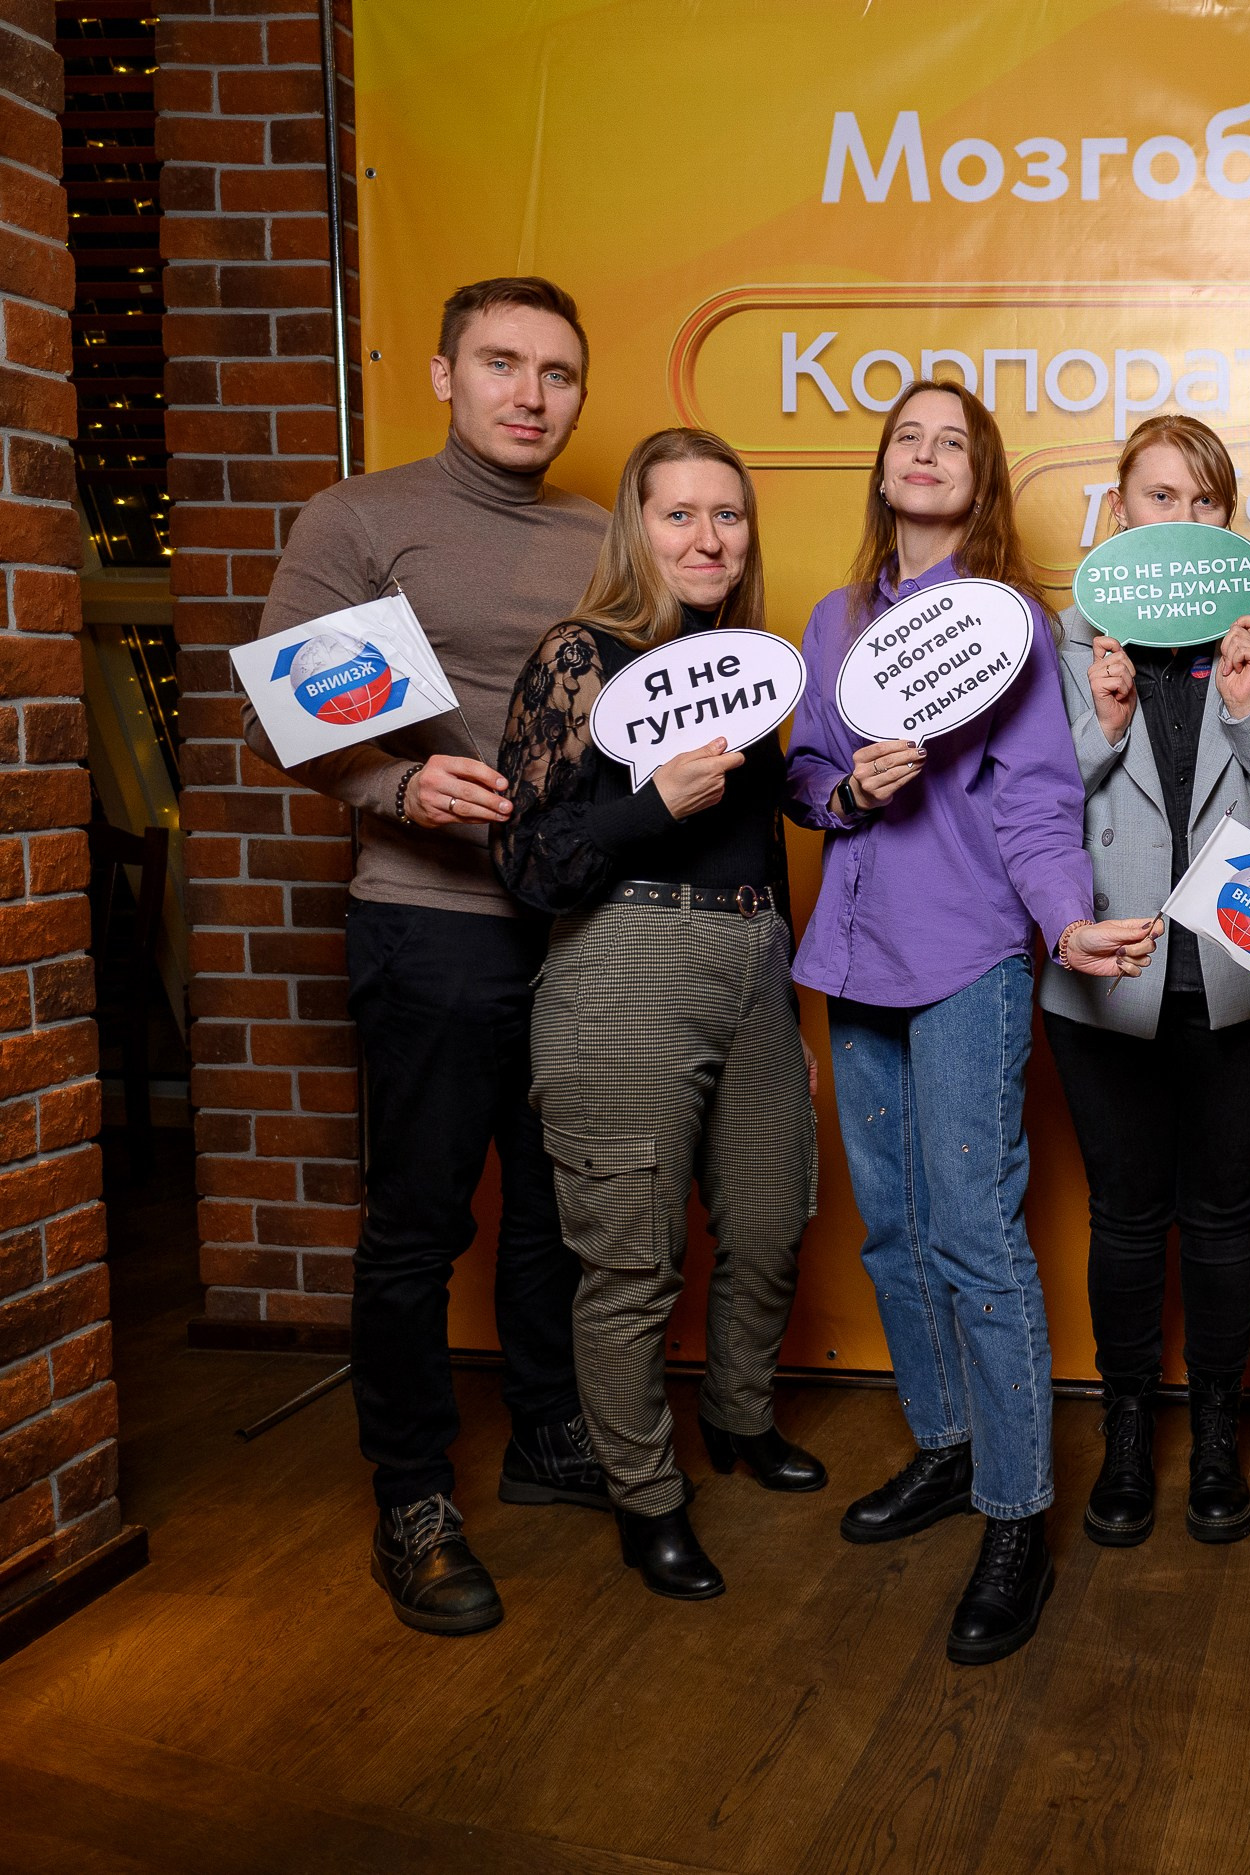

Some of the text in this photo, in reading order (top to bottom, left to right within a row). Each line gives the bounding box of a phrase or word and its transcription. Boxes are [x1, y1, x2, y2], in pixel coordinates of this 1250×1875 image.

[1087, 565, 1129, 583] ЭТО
[1135, 563, 1163, 579] НЕ
[1094, 583, 1163, 604] ЗДЕСЬ
[866, 596, 954, 658] Хорошо
[1137, 600, 1217, 620] НУЖНО
[873, 613, 982, 690] работаем,
[899, 642, 982, 702] хорошо
[305, 661, 377, 698] ВНИИЗЖ
[644, 655, 741, 702] Я не
[903, 651, 1012, 731] отдыхаем!
[625, 678, 777, 745] гуглил
